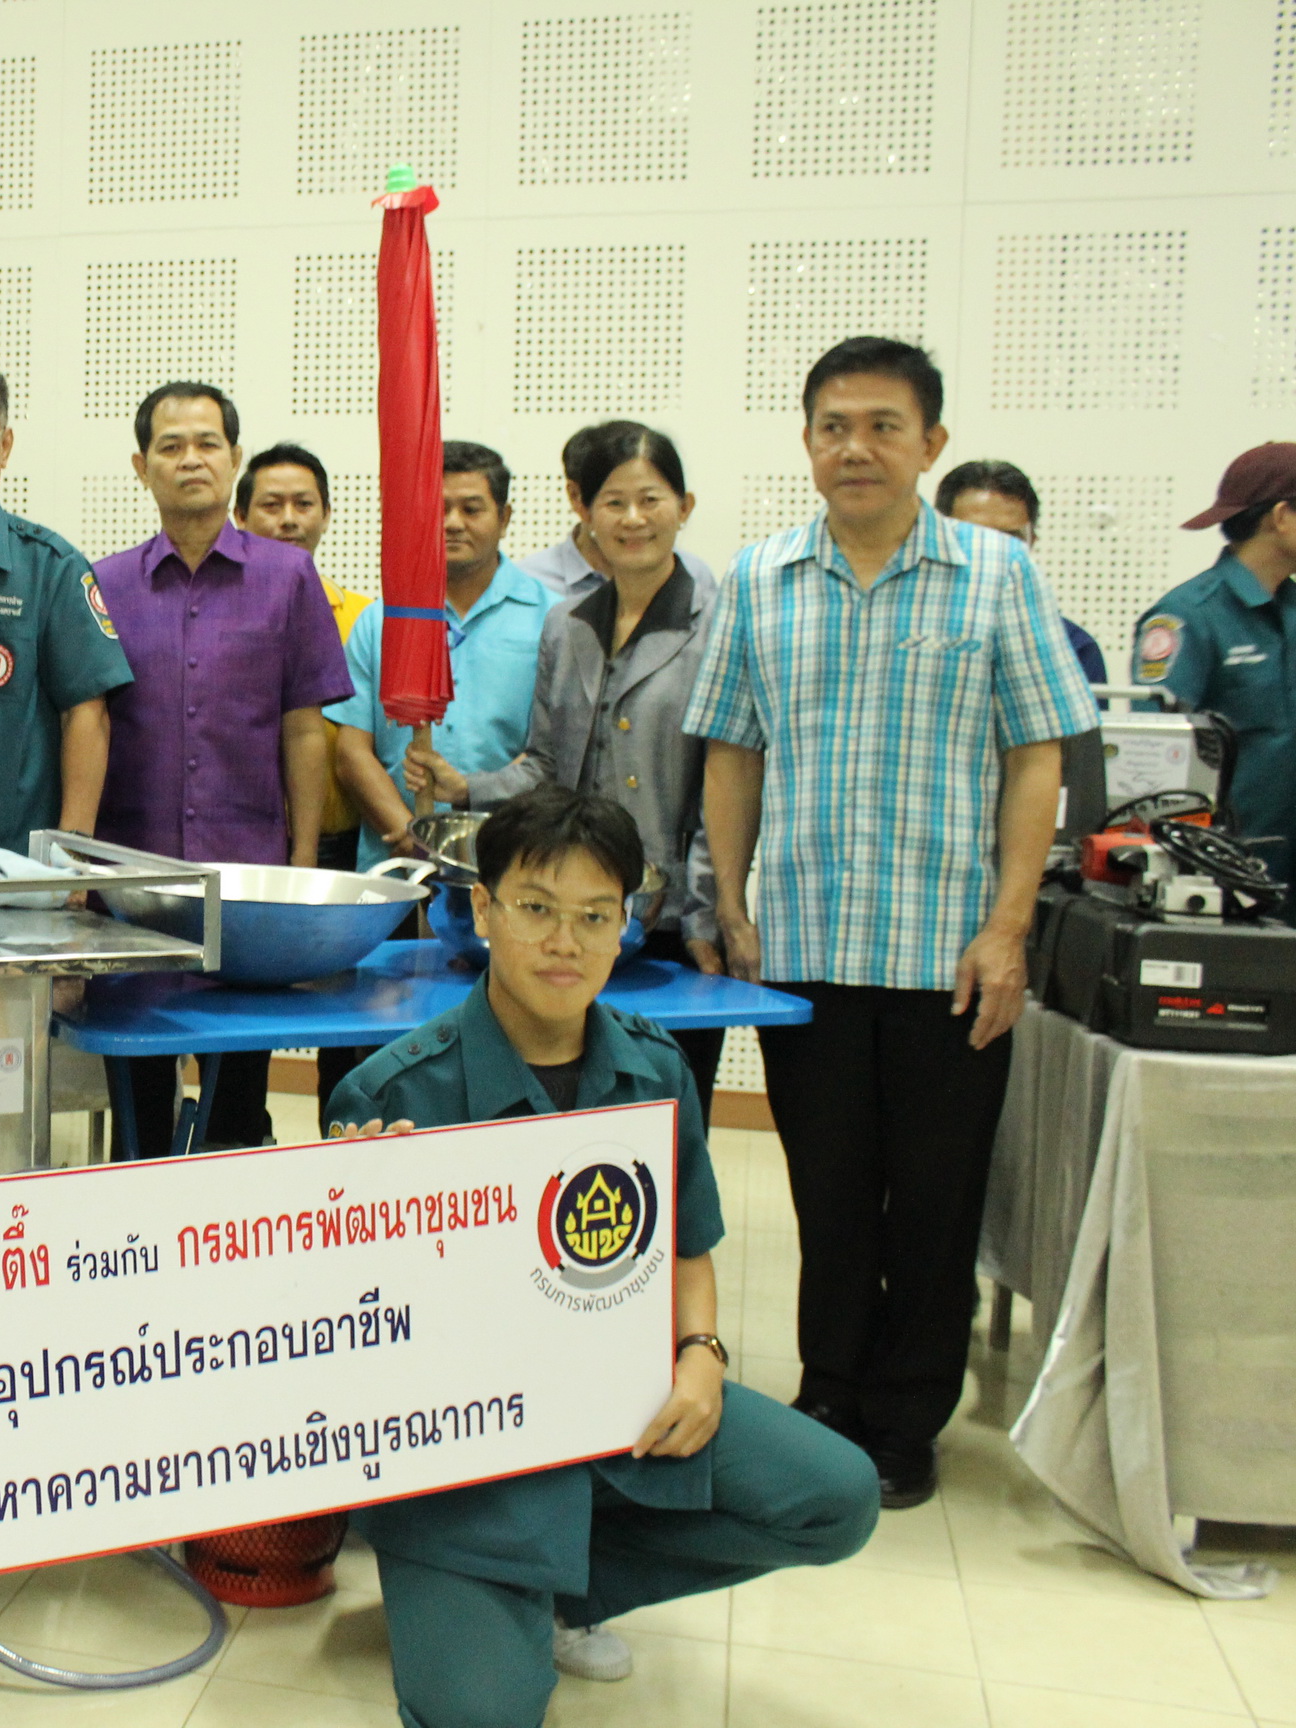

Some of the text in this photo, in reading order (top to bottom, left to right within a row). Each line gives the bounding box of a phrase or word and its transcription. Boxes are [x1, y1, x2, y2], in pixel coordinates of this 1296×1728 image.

[66, 1233, 159, 1282] ร่วมกับ
[177, 1184, 517, 1268] กรมการพัฒนาชุมชน
[530, 1248, 665, 1313] กรมการพัฒนาชุมชน
